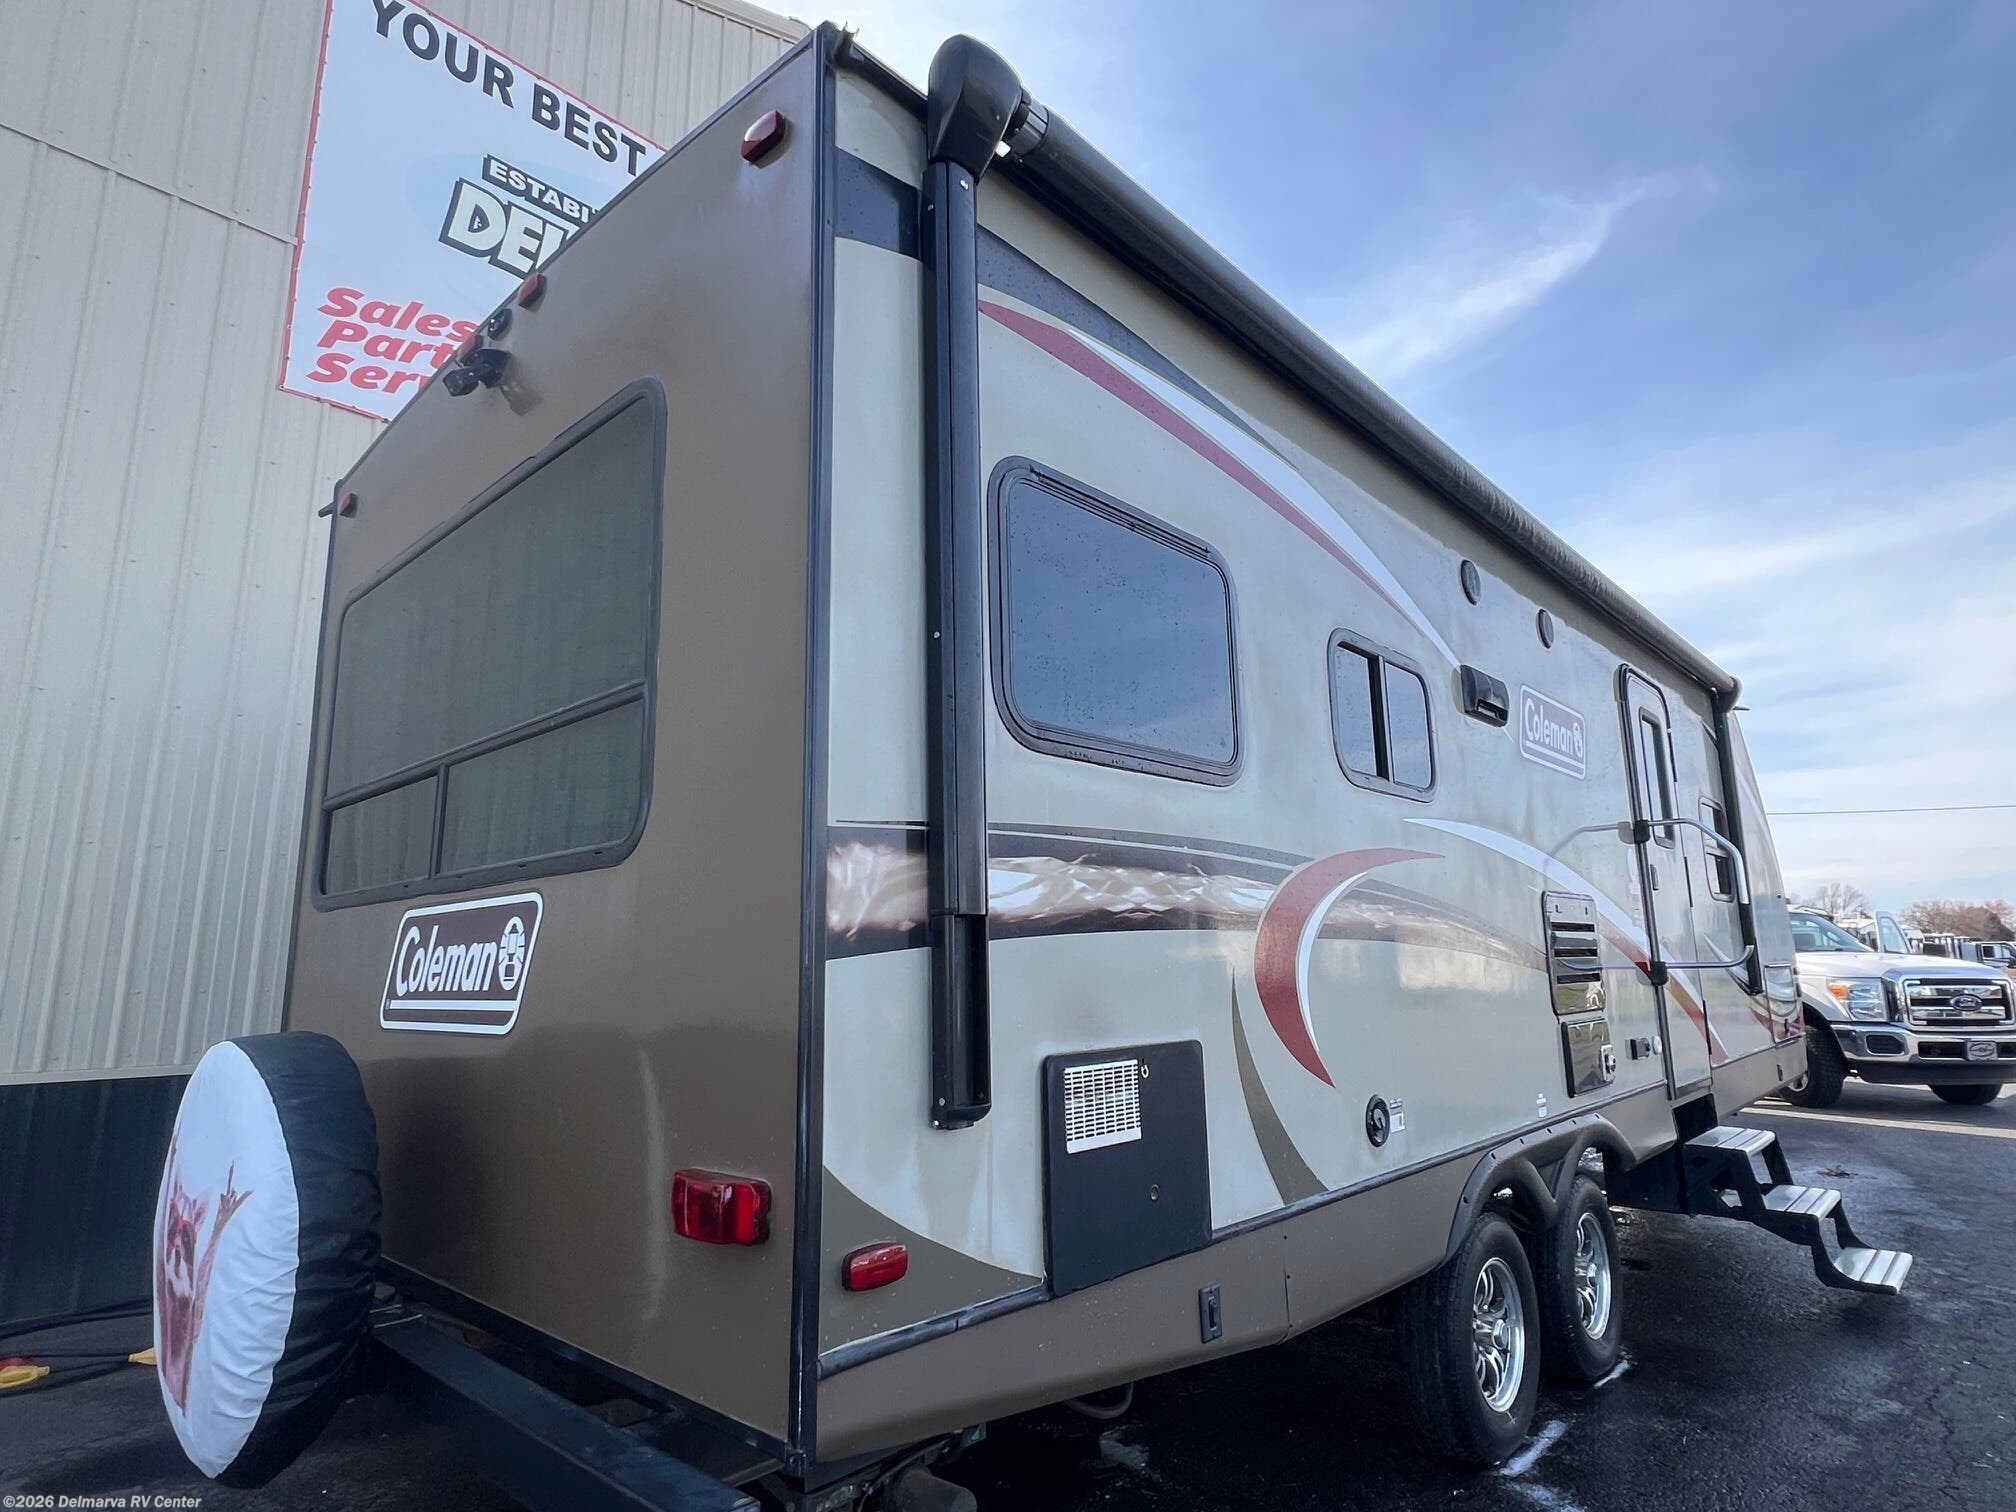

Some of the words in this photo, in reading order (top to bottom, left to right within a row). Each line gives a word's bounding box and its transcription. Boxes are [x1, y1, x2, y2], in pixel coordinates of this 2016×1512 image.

[373, 0, 514, 108] YOUR
[531, 83, 647, 177] BEST
[317, 287, 480, 343] Sales
[1525, 698, 1573, 756] Coleman
[396, 925, 498, 997] Coleman
